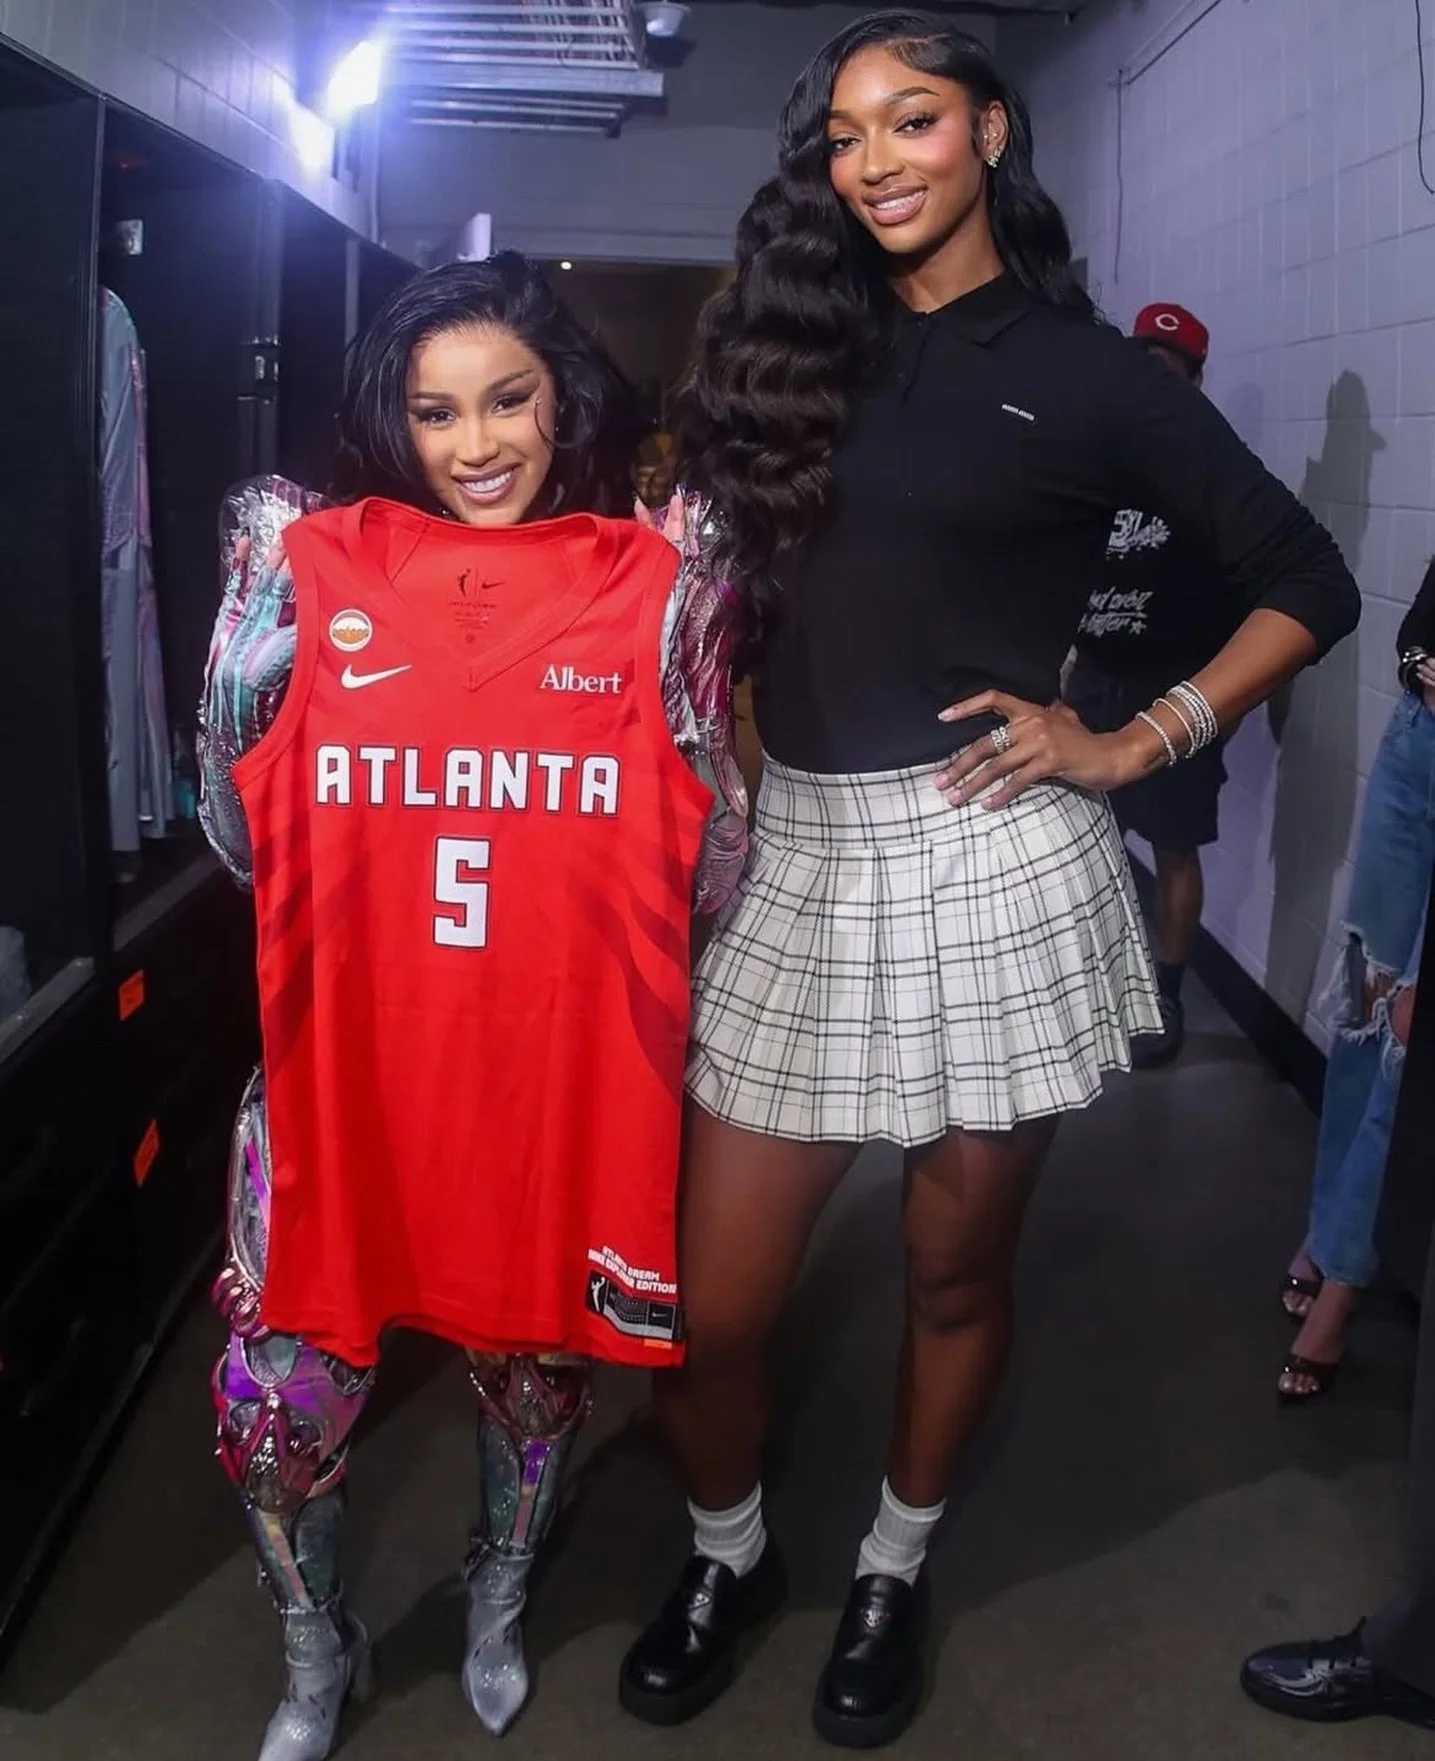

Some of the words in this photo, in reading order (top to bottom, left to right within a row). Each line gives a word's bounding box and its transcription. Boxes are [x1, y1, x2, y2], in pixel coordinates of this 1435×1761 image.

[1155, 313, 1180, 331] C
[539, 664, 622, 694] Albert
[315, 743, 620, 816] ATLANTA
[432, 836, 491, 949] 5
[636, 1280, 678, 1294] EDITION
